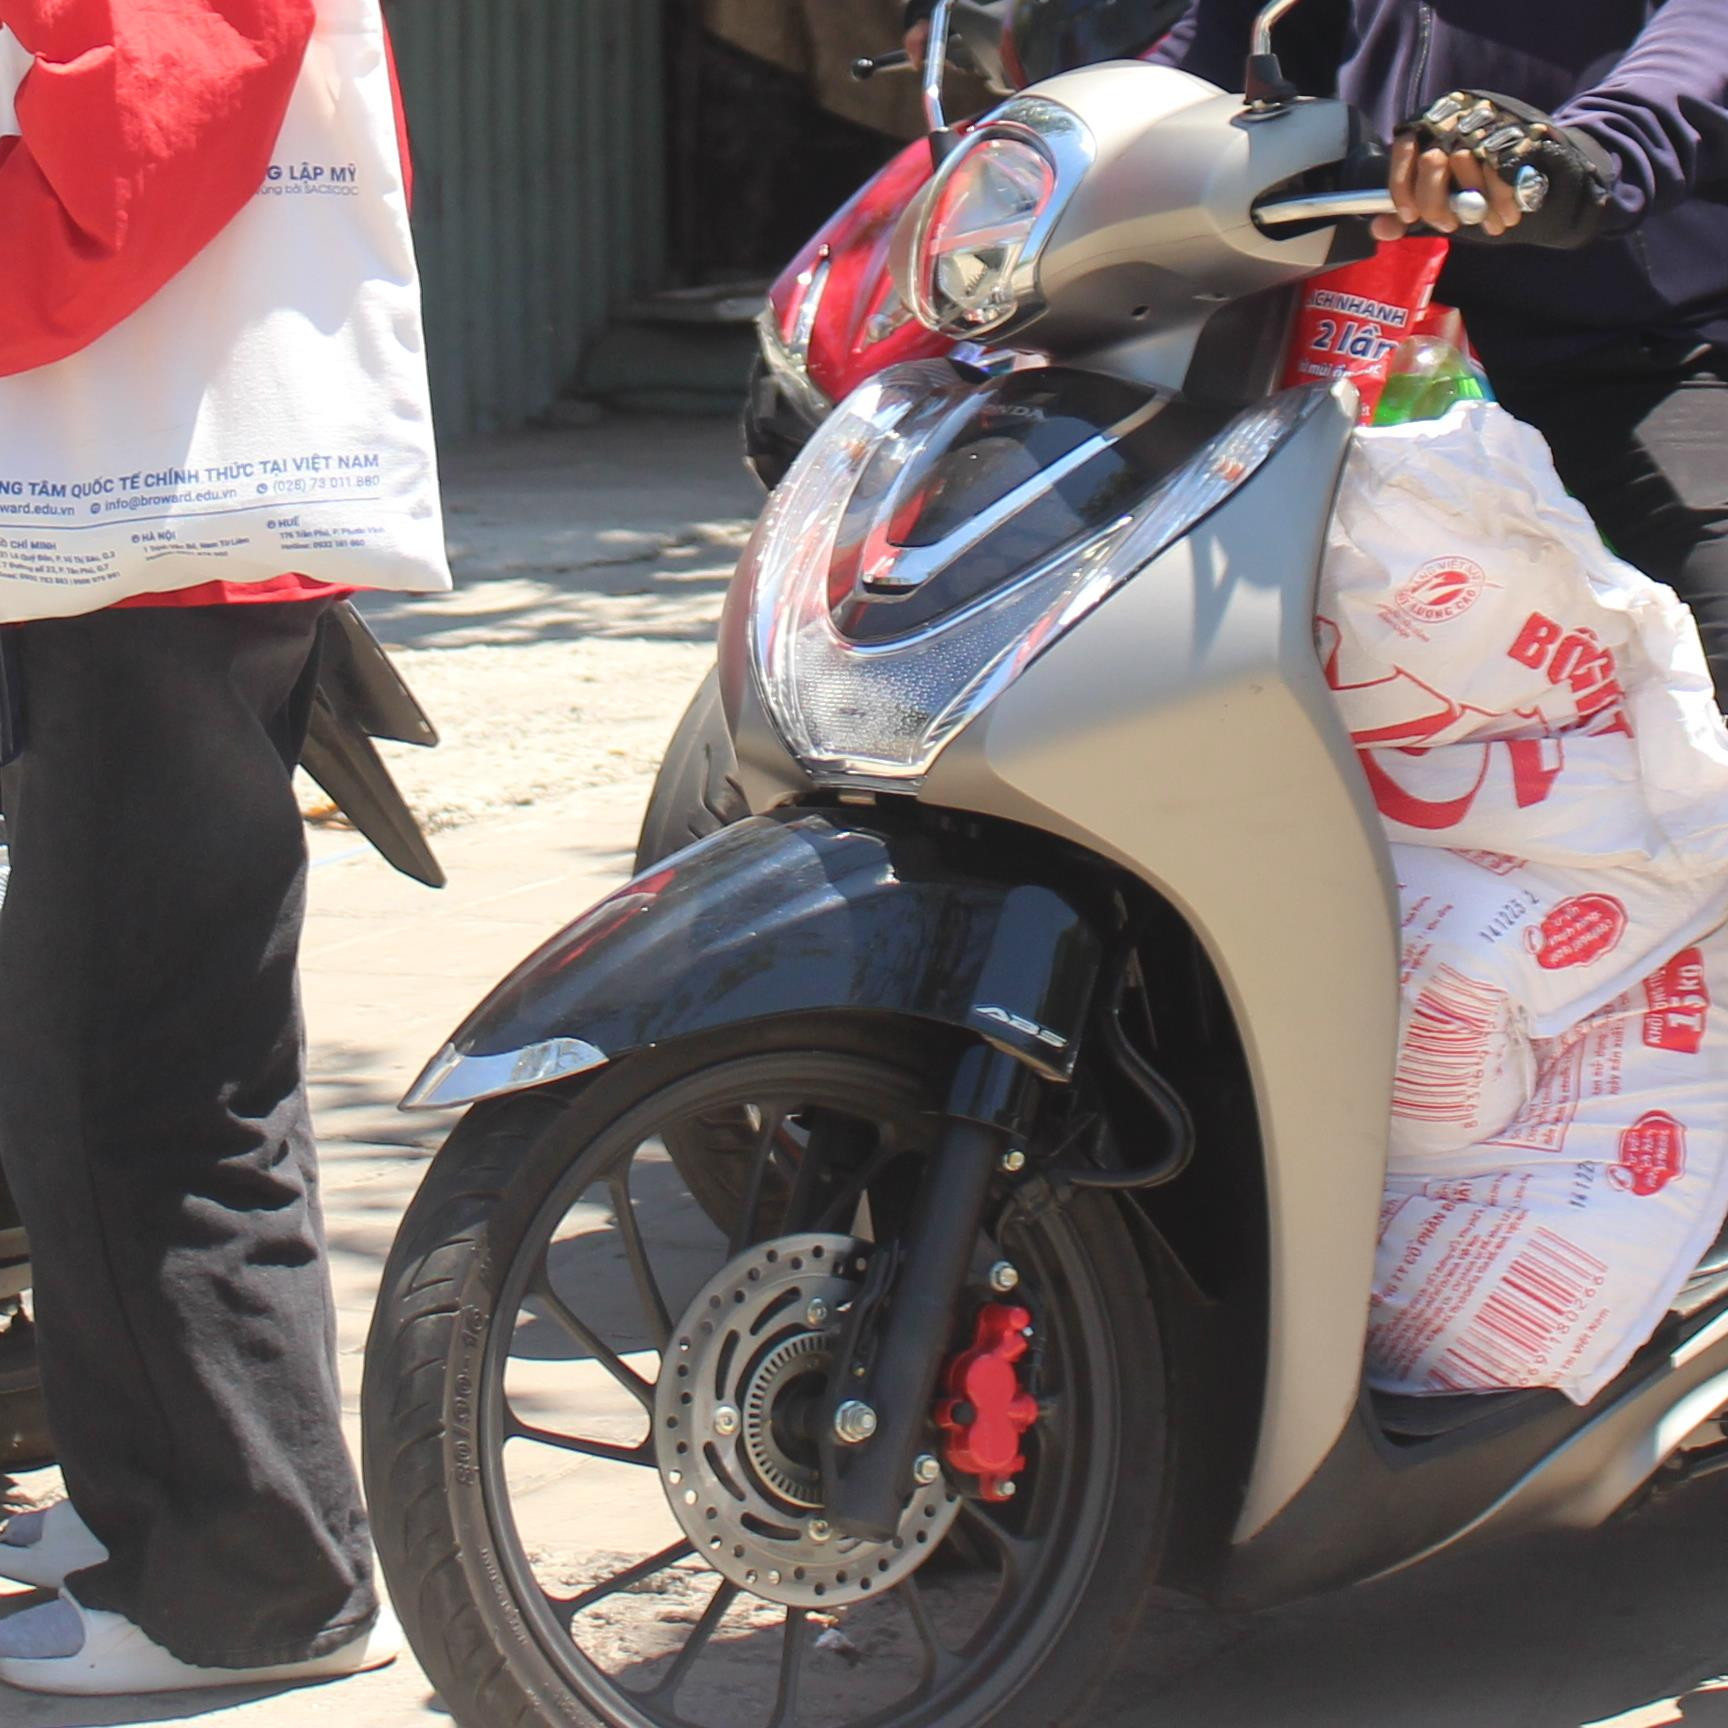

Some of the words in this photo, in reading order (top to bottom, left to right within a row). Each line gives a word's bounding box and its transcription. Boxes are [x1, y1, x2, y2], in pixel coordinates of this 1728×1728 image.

[289, 161, 324, 184] LẬP
[330, 163, 356, 183] MỸ
[1336, 294, 1409, 328] NHANH
[1312, 319, 1336, 351] 2
[28, 480, 67, 498] TÂM
[71, 473, 115, 499] QUỐC
[118, 470, 142, 492] TẾ
[145, 466, 200, 489] CHÍNH
[205, 462, 255, 482] THỨC
[259, 459, 288, 477] TẠI
[292, 455, 332, 474] VIỆT
[338, 453, 379, 470] NAM
[104, 488, 237, 512] info@broward.edu.vn
[10, 537, 28, 550] CHÍ
[142, 531, 156, 542] HÀ
[158, 530, 176, 542] NỘI
[975, 1007, 1069, 1047] ABS
